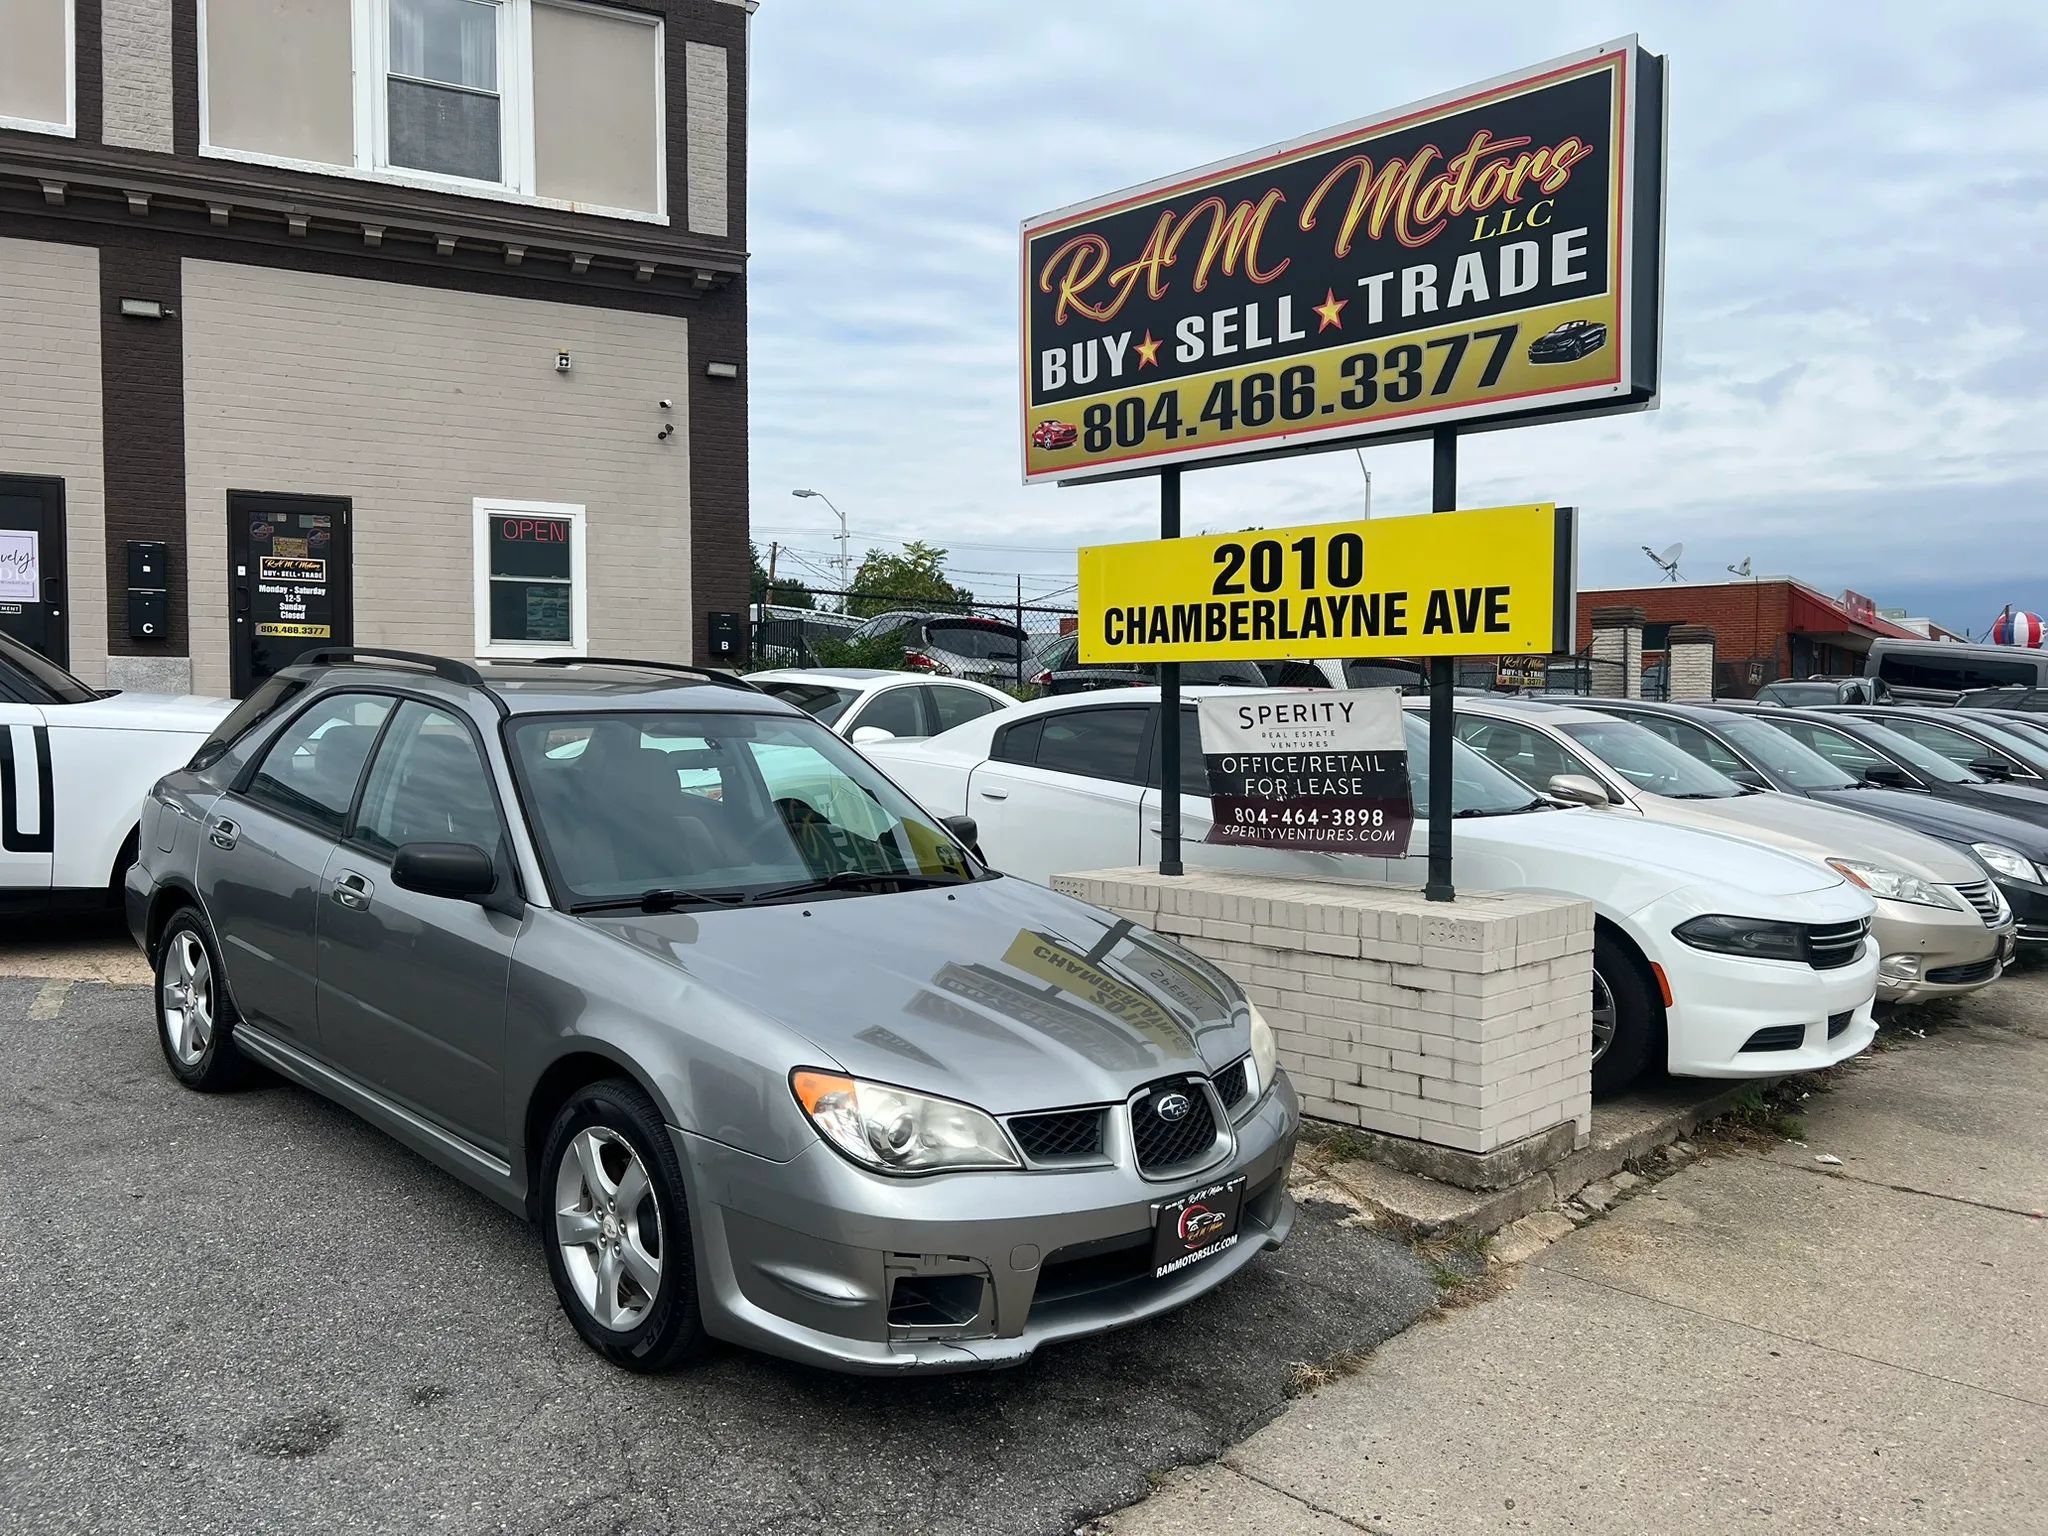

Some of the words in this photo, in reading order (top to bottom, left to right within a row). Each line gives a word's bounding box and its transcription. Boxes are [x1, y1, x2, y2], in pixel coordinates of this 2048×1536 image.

[1040, 188, 1291, 325] RAM
[1299, 128, 1594, 259] Motors
[1469, 199, 1556, 243] LLC
[1041, 330, 1134, 392] BUY
[1175, 296, 1306, 364] SELL
[1357, 226, 1588, 325] TRADE
[1082, 322, 1520, 456] 804.466.3377
[503, 519, 565, 541] OPEN
[1211, 532, 1364, 596] 2010
[259, 584, 288, 594] Monday
[294, 586, 326, 596] Saturday
[279, 602, 307, 612] Sunday
[280, 611, 306, 620] Closed
[1103, 591, 1408, 647] CHAMBERLAYNE
[1422, 585, 1511, 635] AVE
[142, 623, 154, 634] C
[721, 641, 729, 650] B
[1238, 702, 1355, 730] SPERITY
[1261, 731, 1288, 739] REAL
[1295, 730, 1336, 738] ESTATE
[1271, 741, 1329, 749] VENTURES
[1221, 755, 1386, 774] OFFICE/RETAIL
[1244, 778, 1288, 796] FOR
[1297, 778, 1364, 796] LEASE
[1234, 808, 1385, 827] 804-464-3898
[1222, 824, 1396, 842] SPERITYVENTURES.COM
